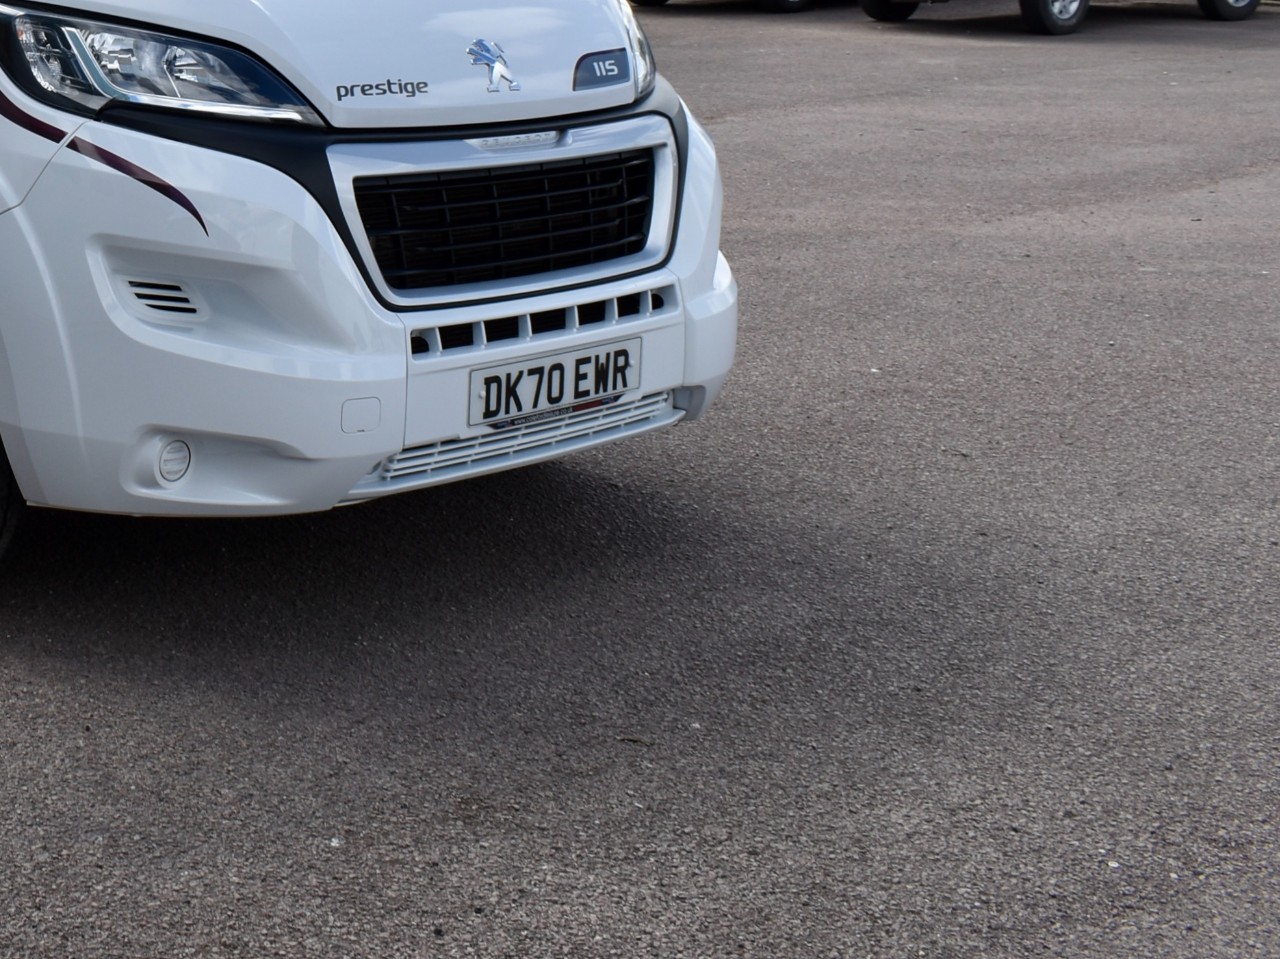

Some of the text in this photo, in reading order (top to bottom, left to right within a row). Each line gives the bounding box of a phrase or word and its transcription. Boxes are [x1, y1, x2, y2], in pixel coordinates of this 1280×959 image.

[593, 60, 618, 76] 115
[336, 79, 428, 101] prestige
[482, 349, 630, 420] DK70 EWR
